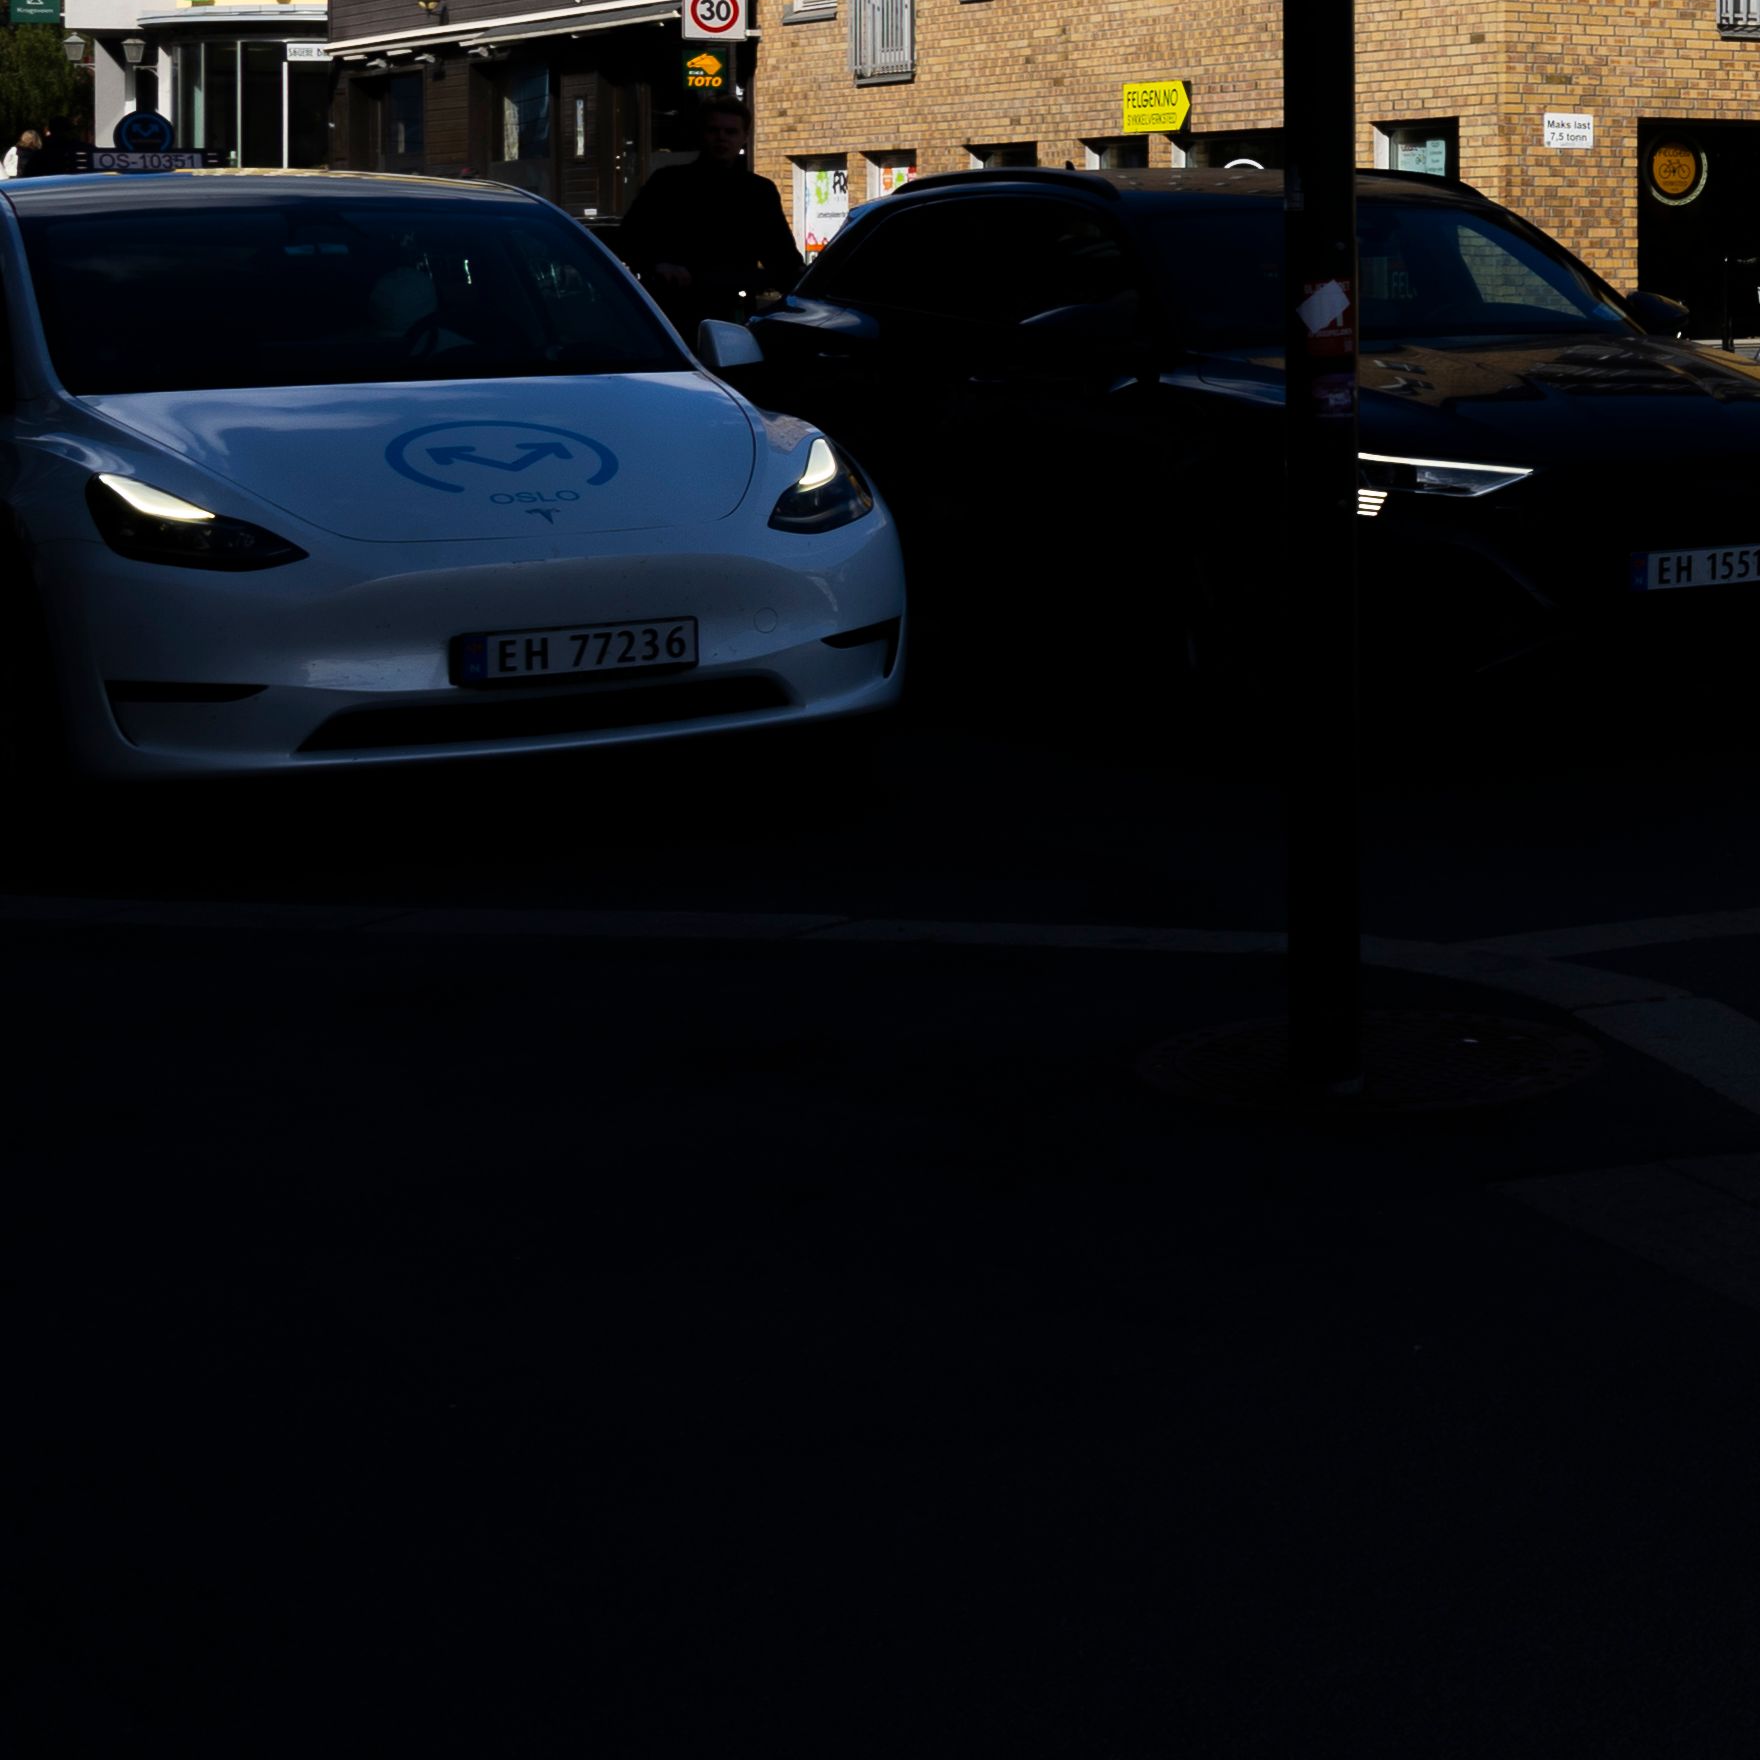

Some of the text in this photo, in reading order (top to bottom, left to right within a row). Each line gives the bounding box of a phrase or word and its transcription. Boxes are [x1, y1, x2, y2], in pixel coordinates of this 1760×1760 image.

[700, 0, 731, 22] 30
[687, 76, 722, 87] TOTO
[1127, 88, 1178, 109] FELGEN.NO
[1547, 120, 1591, 130] Maks last
[1566, 133, 1588, 142] tonn
[99, 153, 196, 169] OS-10351
[490, 490, 579, 505] OSLO
[1658, 555, 1692, 585] EH
[500, 638, 548, 673] EH
[570, 626, 686, 667] 77236
